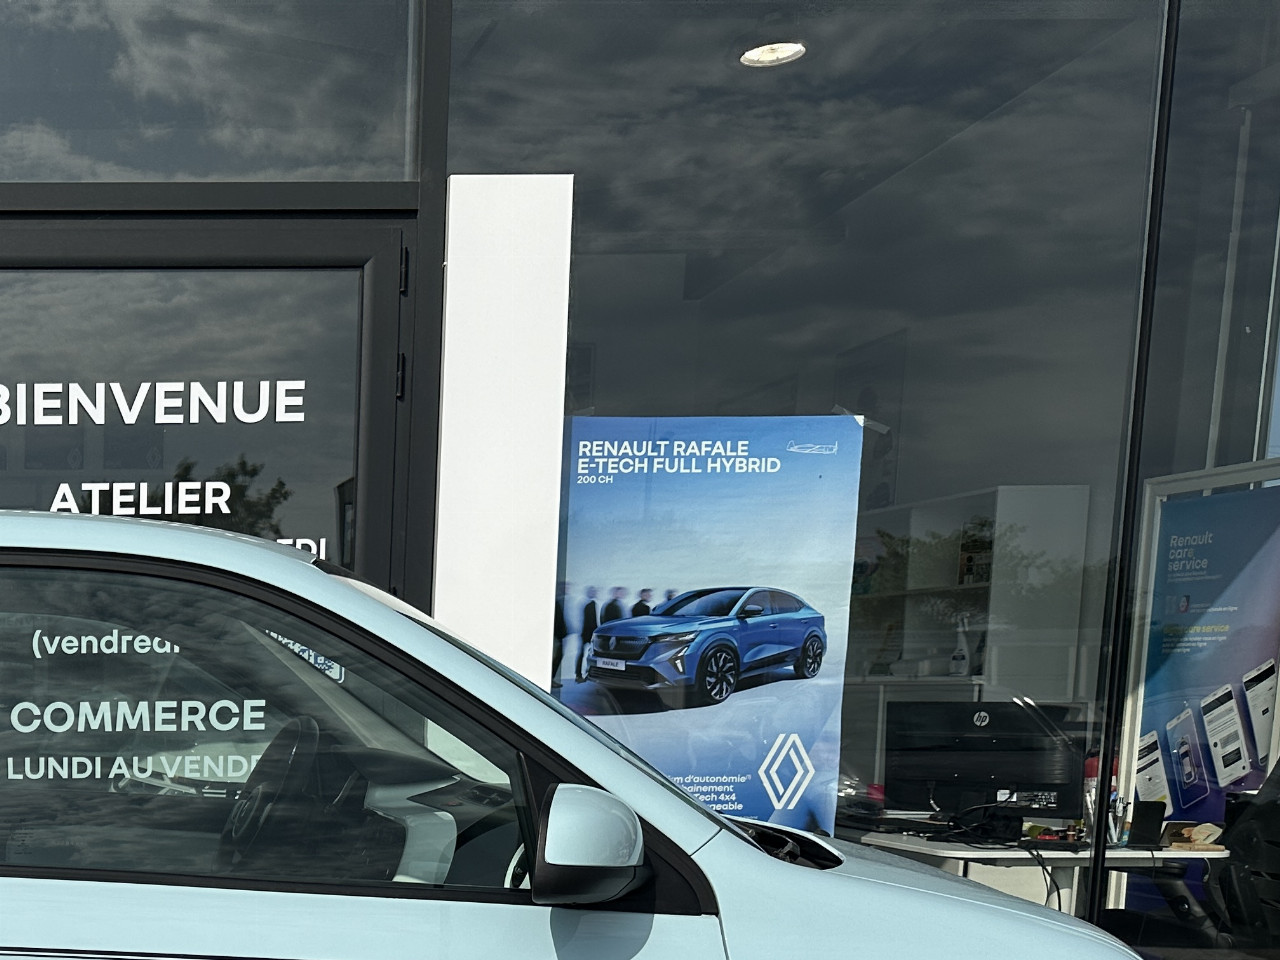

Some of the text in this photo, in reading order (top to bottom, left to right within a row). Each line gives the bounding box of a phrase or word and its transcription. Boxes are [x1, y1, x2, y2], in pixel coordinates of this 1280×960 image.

[578, 440, 749, 456] RENAULT RAFALE
[577, 457, 781, 473] E-TECH FULL HYBRID
[577, 475, 613, 484] 200 CH
[49, 481, 232, 515] ATELIER
[1169, 530, 1214, 548] Renault
[1168, 547, 1194, 559] care
[1167, 556, 1209, 572] service
[10, 699, 266, 733] COMMERCE
[974, 711, 990, 727] hp
[7, 756, 101, 780] LUNDI
[108, 756, 153, 779] AU
